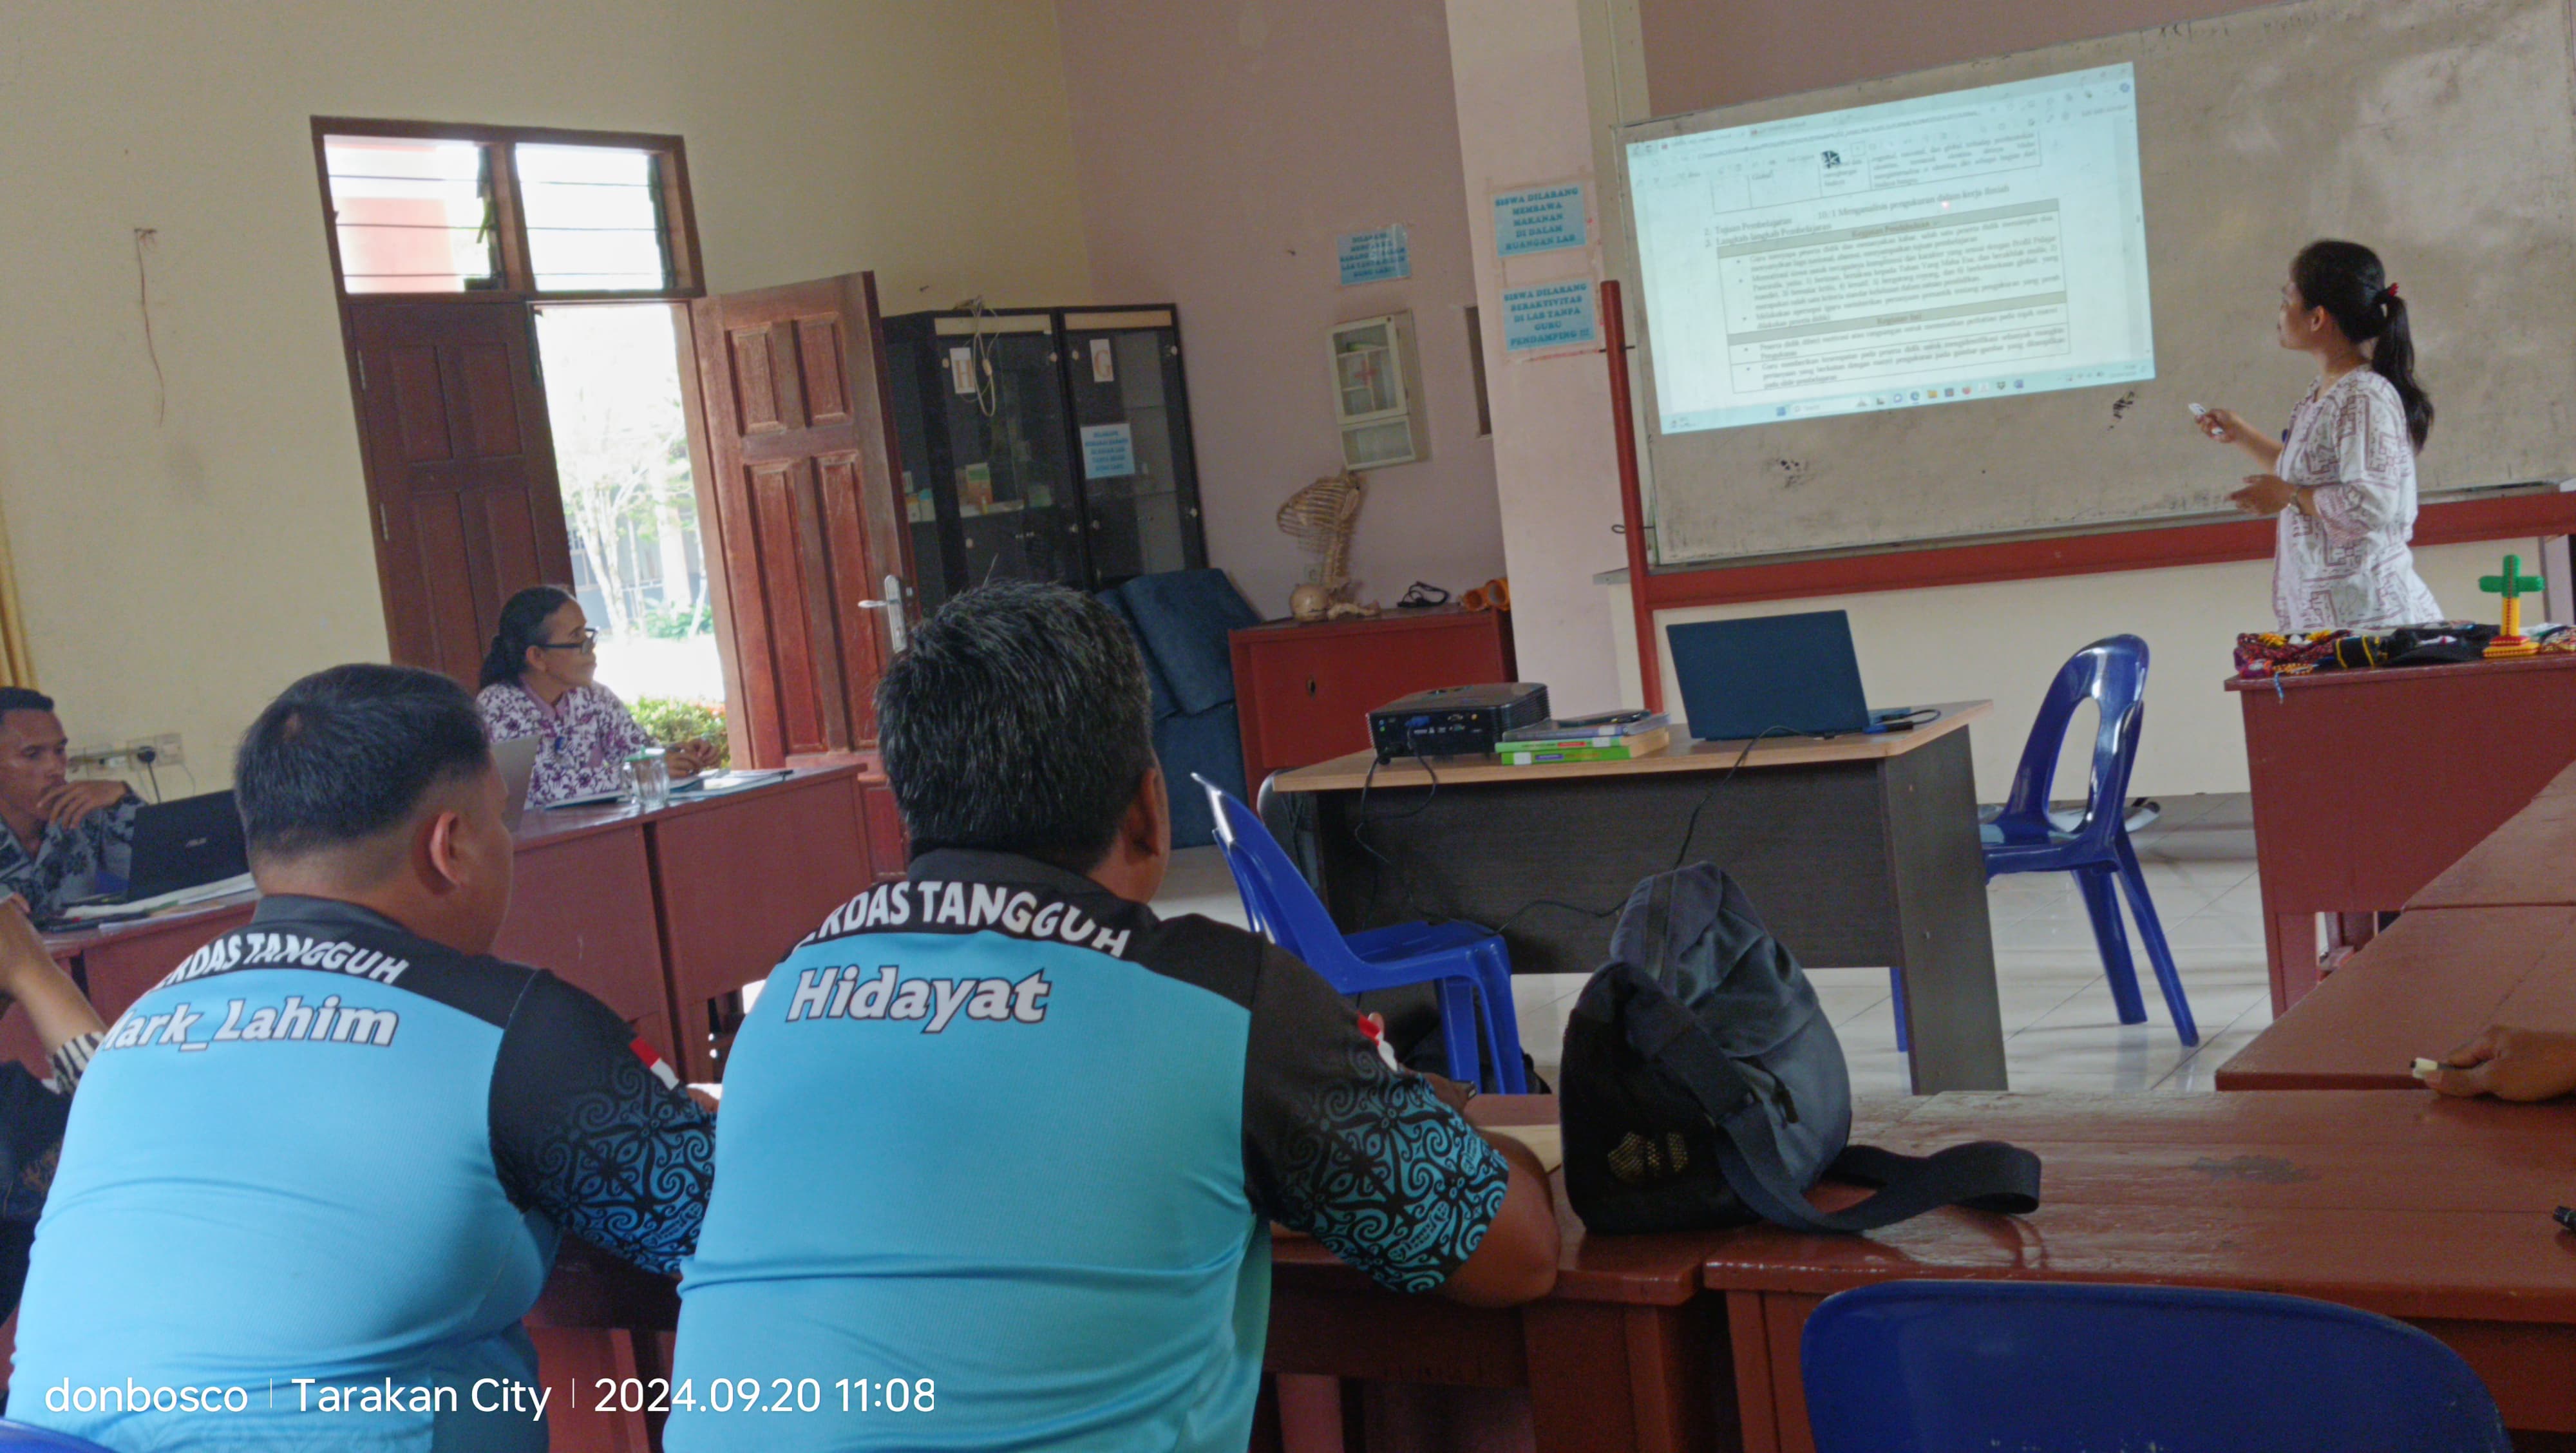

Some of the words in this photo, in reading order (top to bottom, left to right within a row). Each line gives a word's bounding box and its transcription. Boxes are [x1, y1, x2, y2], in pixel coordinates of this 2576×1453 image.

[1528, 187, 1578, 202] DILARANG
[1529, 225, 1563, 236] DALAM
[1557, 234, 1575, 243] LAB
[1537, 283, 1587, 297] DILARANG
[1527, 312, 1546, 321] LAB
[1095, 350, 1113, 378] G
[792, 881, 910, 954] RDAS
[918, 881, 1130, 958] TANGGUH
[243, 933, 410, 984] TANGGUH
[785, 964, 1052, 1034] Hidayat
